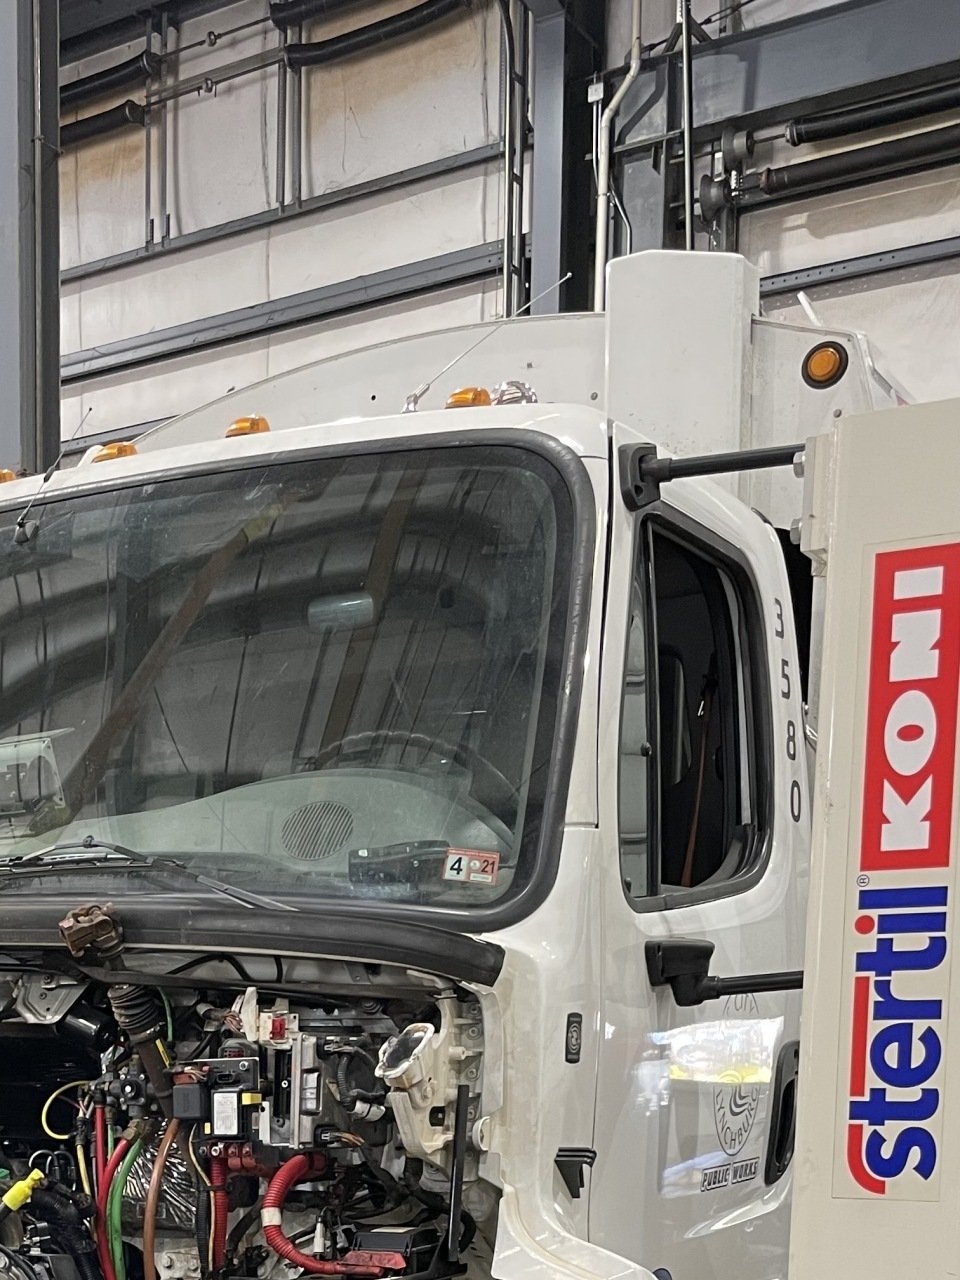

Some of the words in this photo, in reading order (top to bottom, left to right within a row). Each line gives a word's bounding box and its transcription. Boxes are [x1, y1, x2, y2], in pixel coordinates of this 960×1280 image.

[881, 565, 944, 852] KONI
[450, 856, 463, 875] 4
[481, 859, 496, 874] 21
[848, 885, 949, 1182] stertil
[701, 1164, 731, 1191] PUBLIC
[732, 1160, 759, 1183] WORKS
